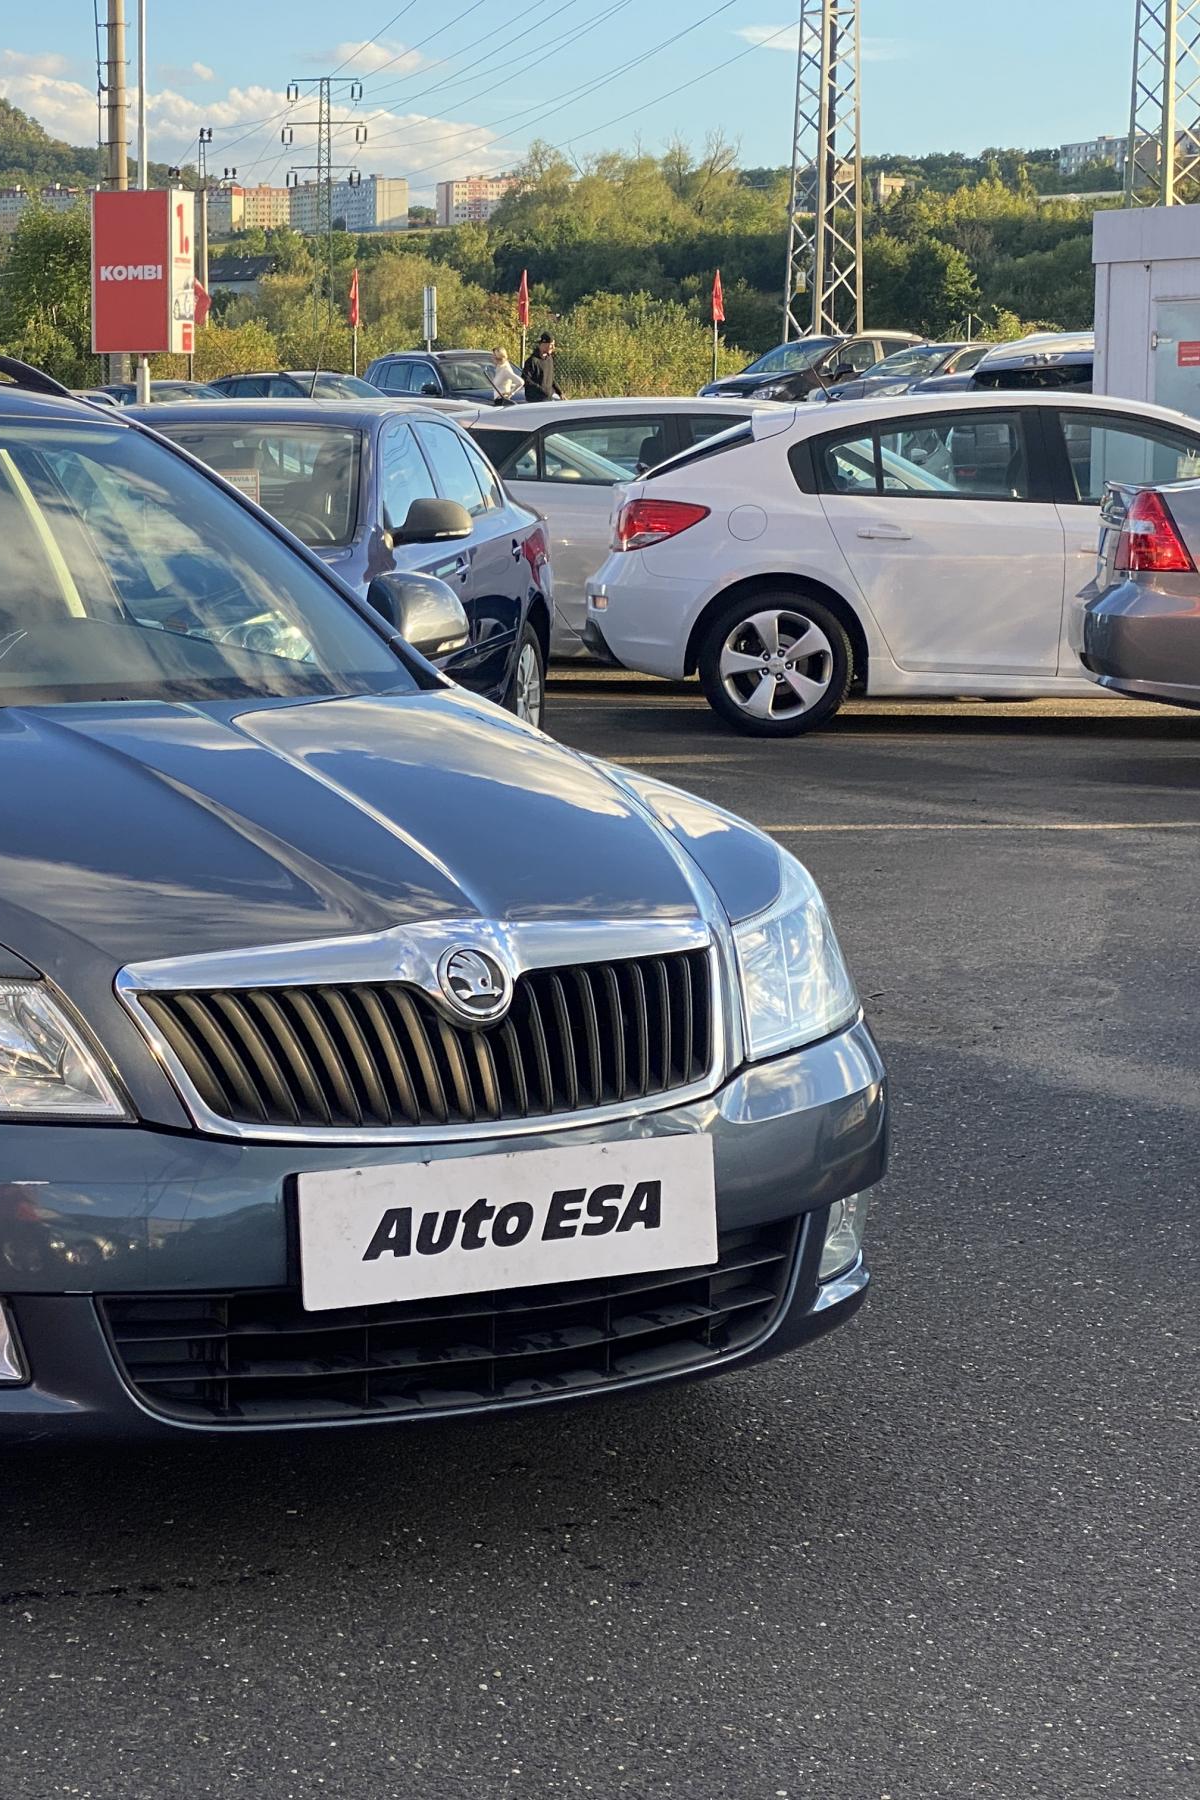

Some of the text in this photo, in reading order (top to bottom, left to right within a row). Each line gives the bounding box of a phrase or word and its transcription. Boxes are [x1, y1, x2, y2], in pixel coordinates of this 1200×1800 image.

[100, 264, 163, 280] KOMBI
[362, 1180, 662, 1262] Auto ESA
